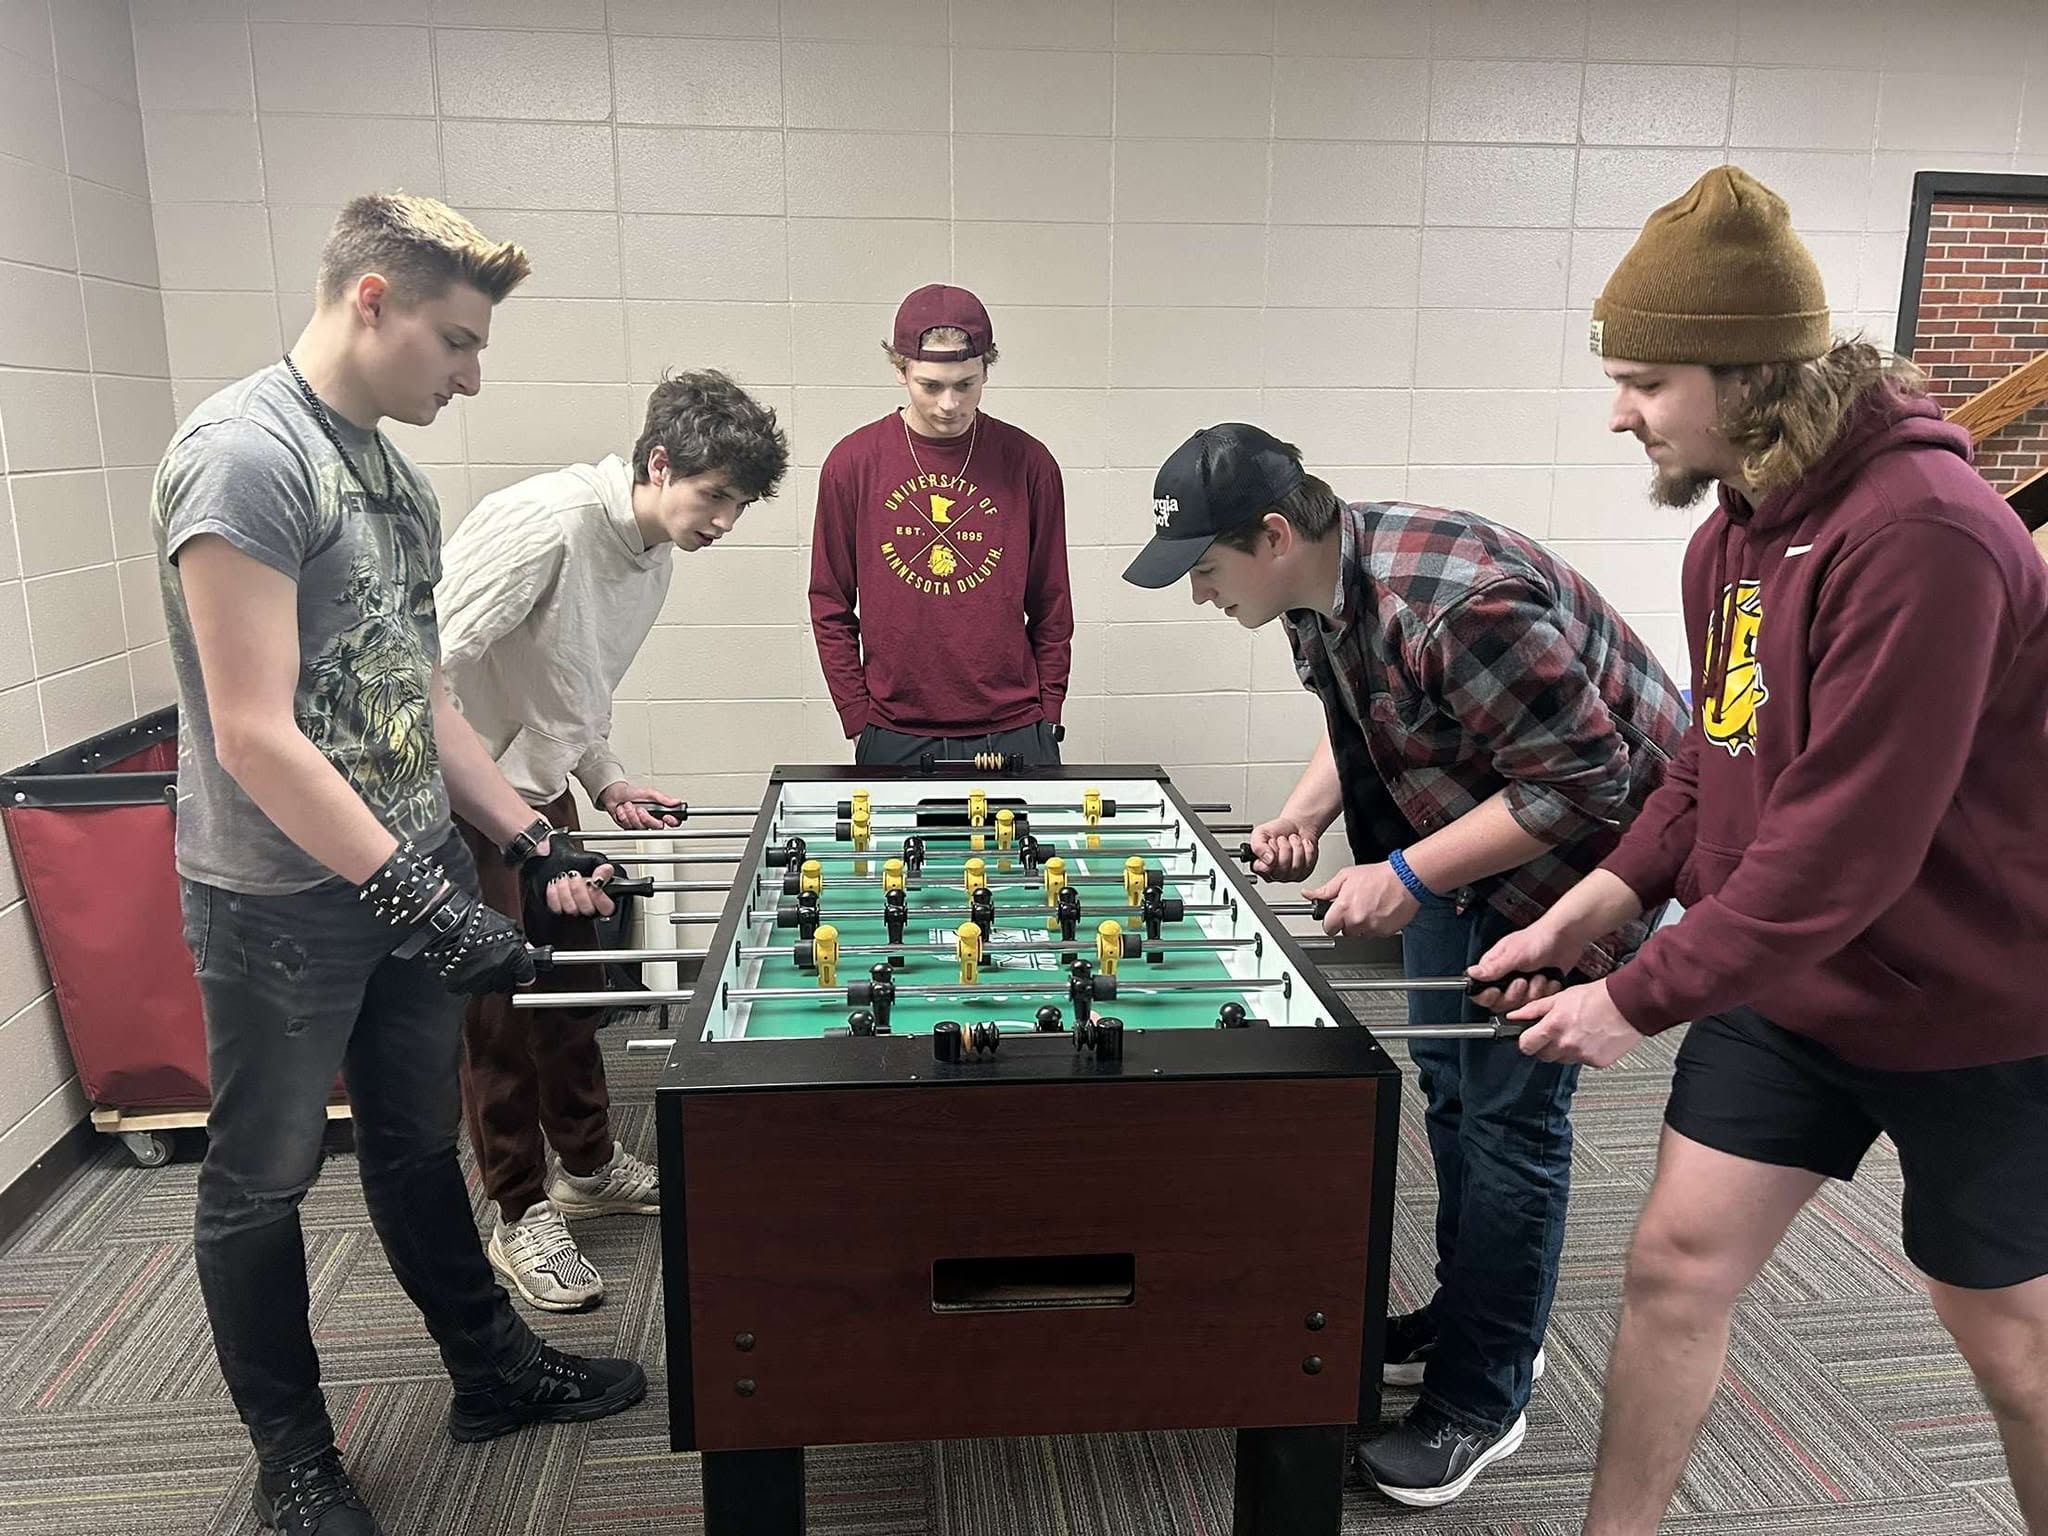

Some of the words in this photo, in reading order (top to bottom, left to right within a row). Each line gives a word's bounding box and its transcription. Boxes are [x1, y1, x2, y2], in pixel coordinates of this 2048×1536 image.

[884, 473, 978, 511] UNIVERSITY
[978, 497, 998, 516] OF
[1153, 495, 1179, 514] rgia
[896, 526, 926, 536] EST.
[955, 531, 983, 542] 1895
[880, 542, 951, 595] MINNESOTA
